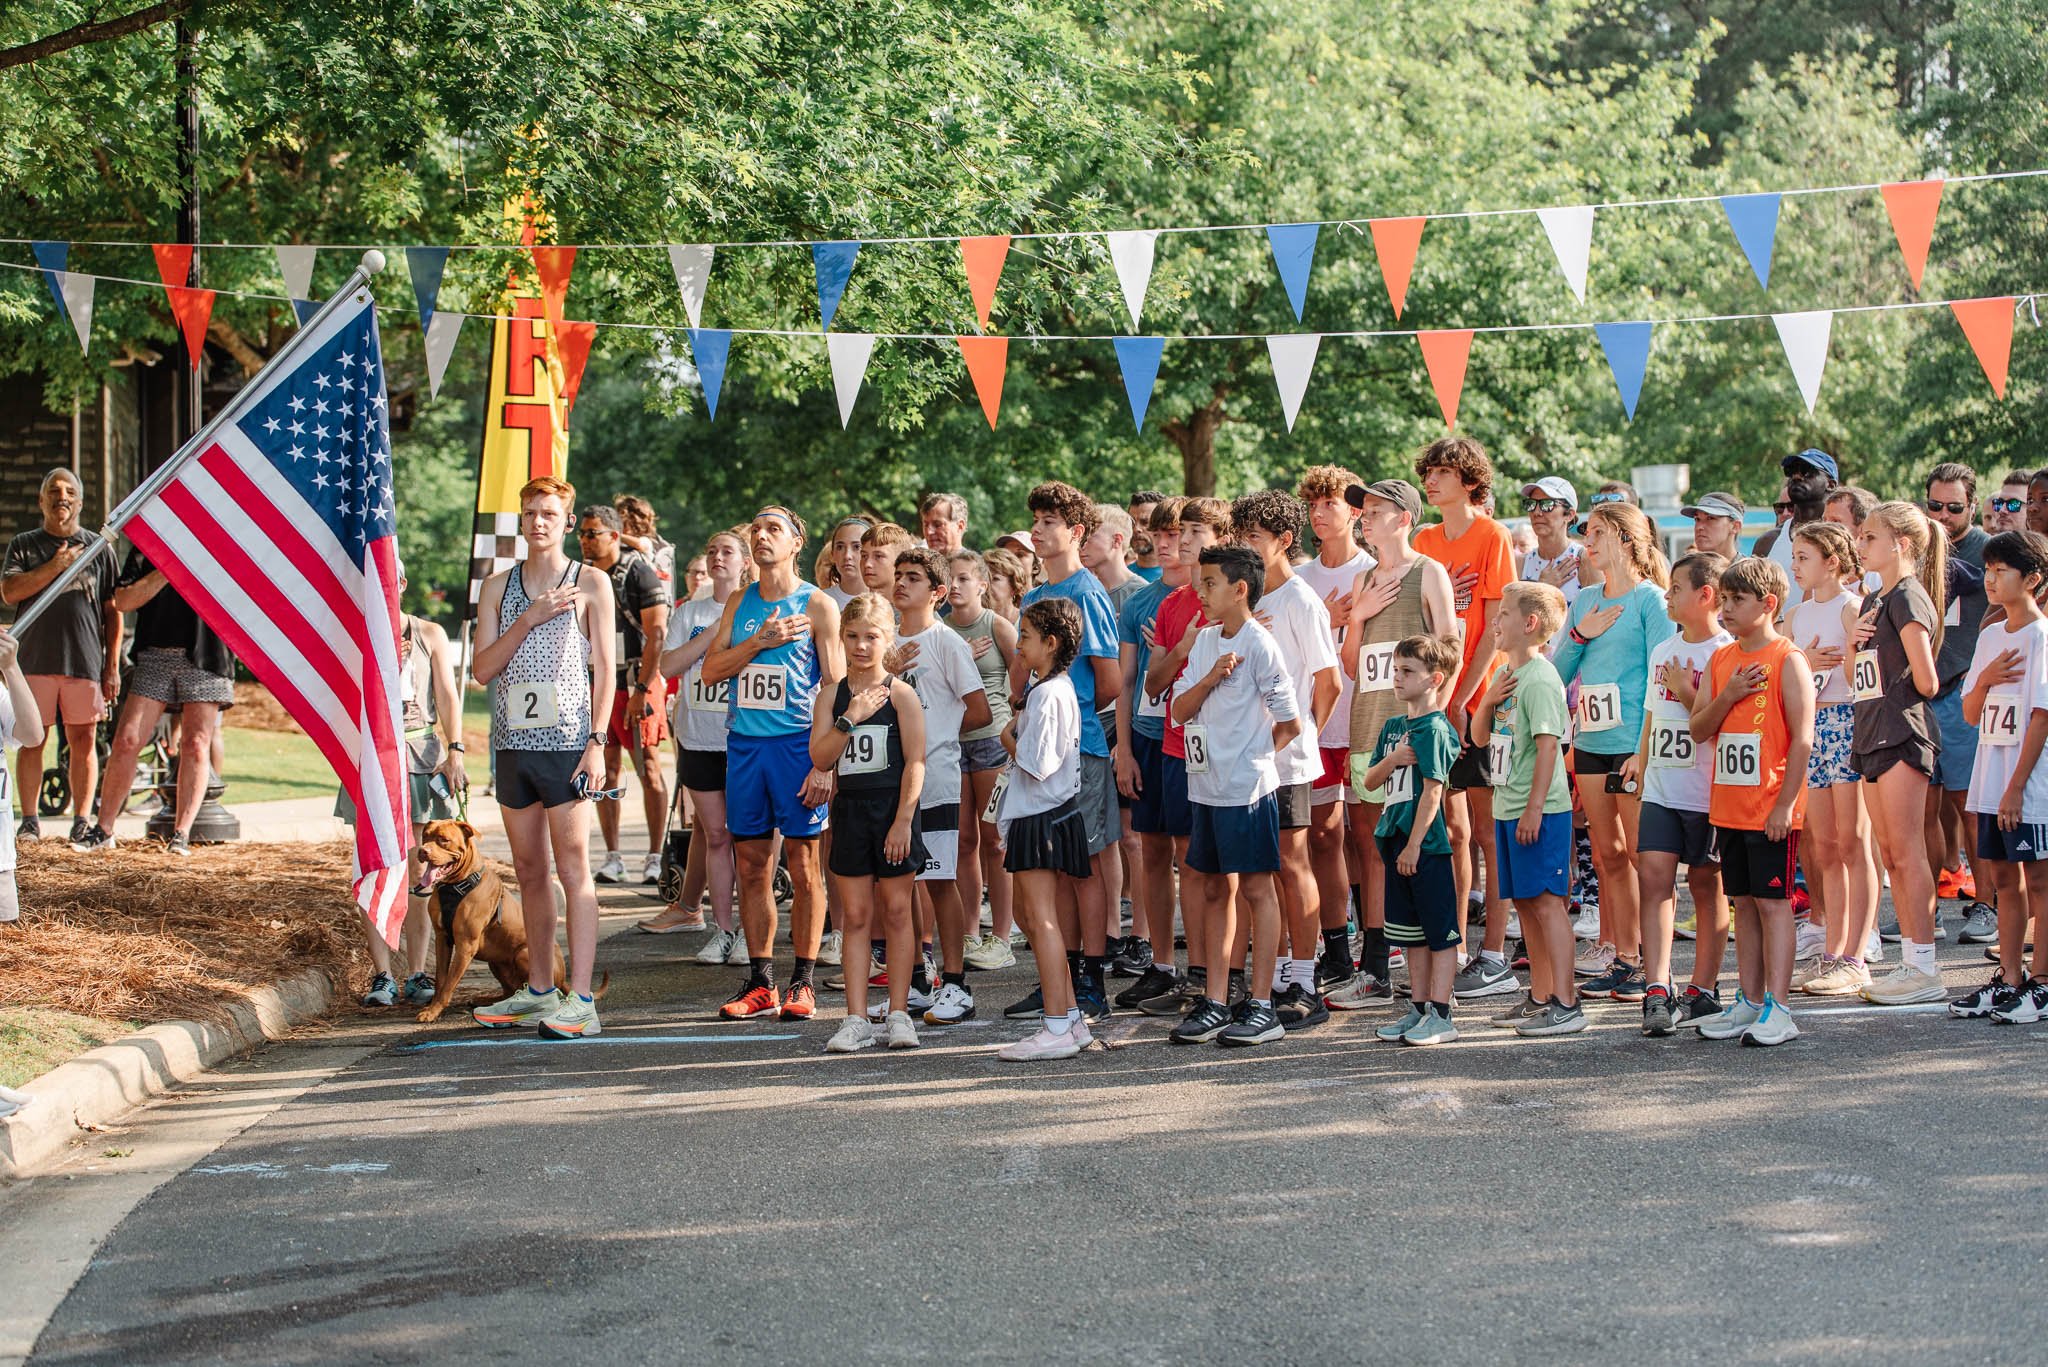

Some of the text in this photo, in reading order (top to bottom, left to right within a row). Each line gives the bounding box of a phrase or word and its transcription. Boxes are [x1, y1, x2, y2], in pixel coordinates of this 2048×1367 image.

[1366, 652, 1393, 682] 97
[1855, 660, 1877, 692] 50
[693, 679, 729, 704] 102
[741, 672, 781, 701] 165
[524, 691, 539, 719] 2
[1579, 692, 1614, 722] 161
[1982, 705, 2017, 736] 174
[845, 734, 874, 764] 49
[1651, 728, 1692, 760] 125
[1718, 743, 1755, 775] 166
